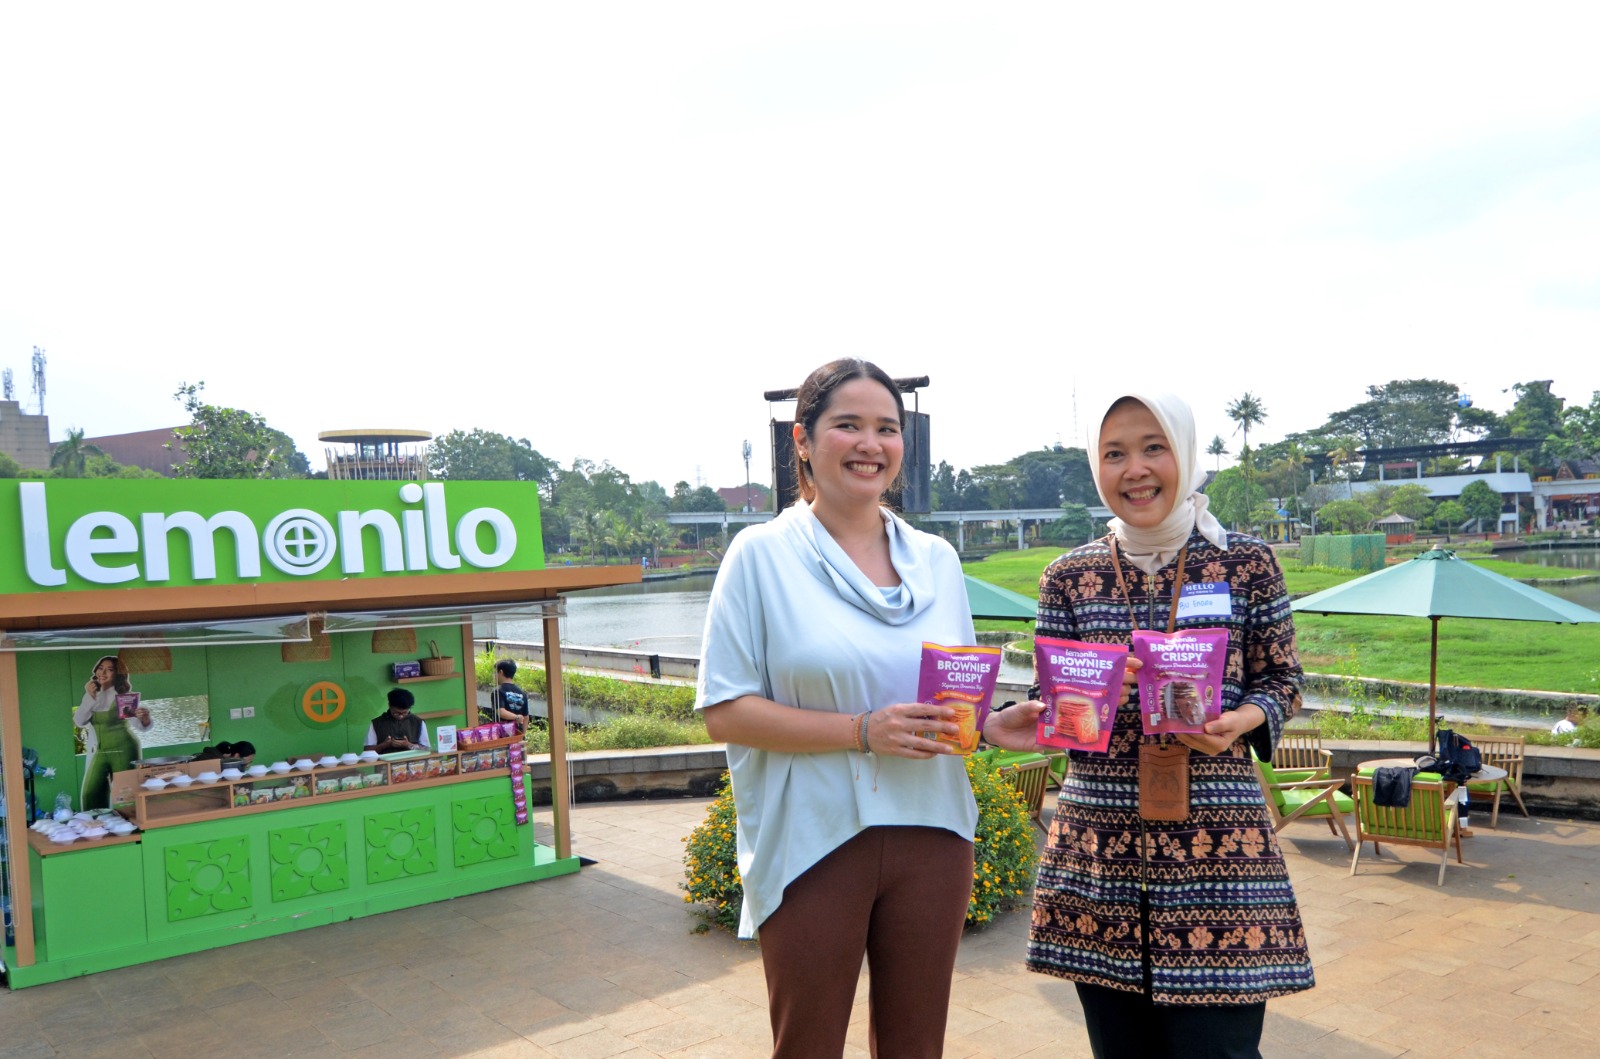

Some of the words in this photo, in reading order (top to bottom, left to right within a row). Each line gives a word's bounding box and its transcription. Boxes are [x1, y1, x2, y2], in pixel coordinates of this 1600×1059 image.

[19, 481, 518, 586] lemonilo
[1185, 583, 1215, 591] HELLO
[1065, 649, 1098, 658] lemonilo
[1150, 643, 1213, 653] BROWNIES
[1050, 655, 1114, 670] BROWNIES
[1161, 652, 1203, 662] CRISPY
[937, 660, 991, 673] BROWNIES
[947, 672, 983, 683] CRISPY
[1061, 666, 1103, 679] CRISPY
